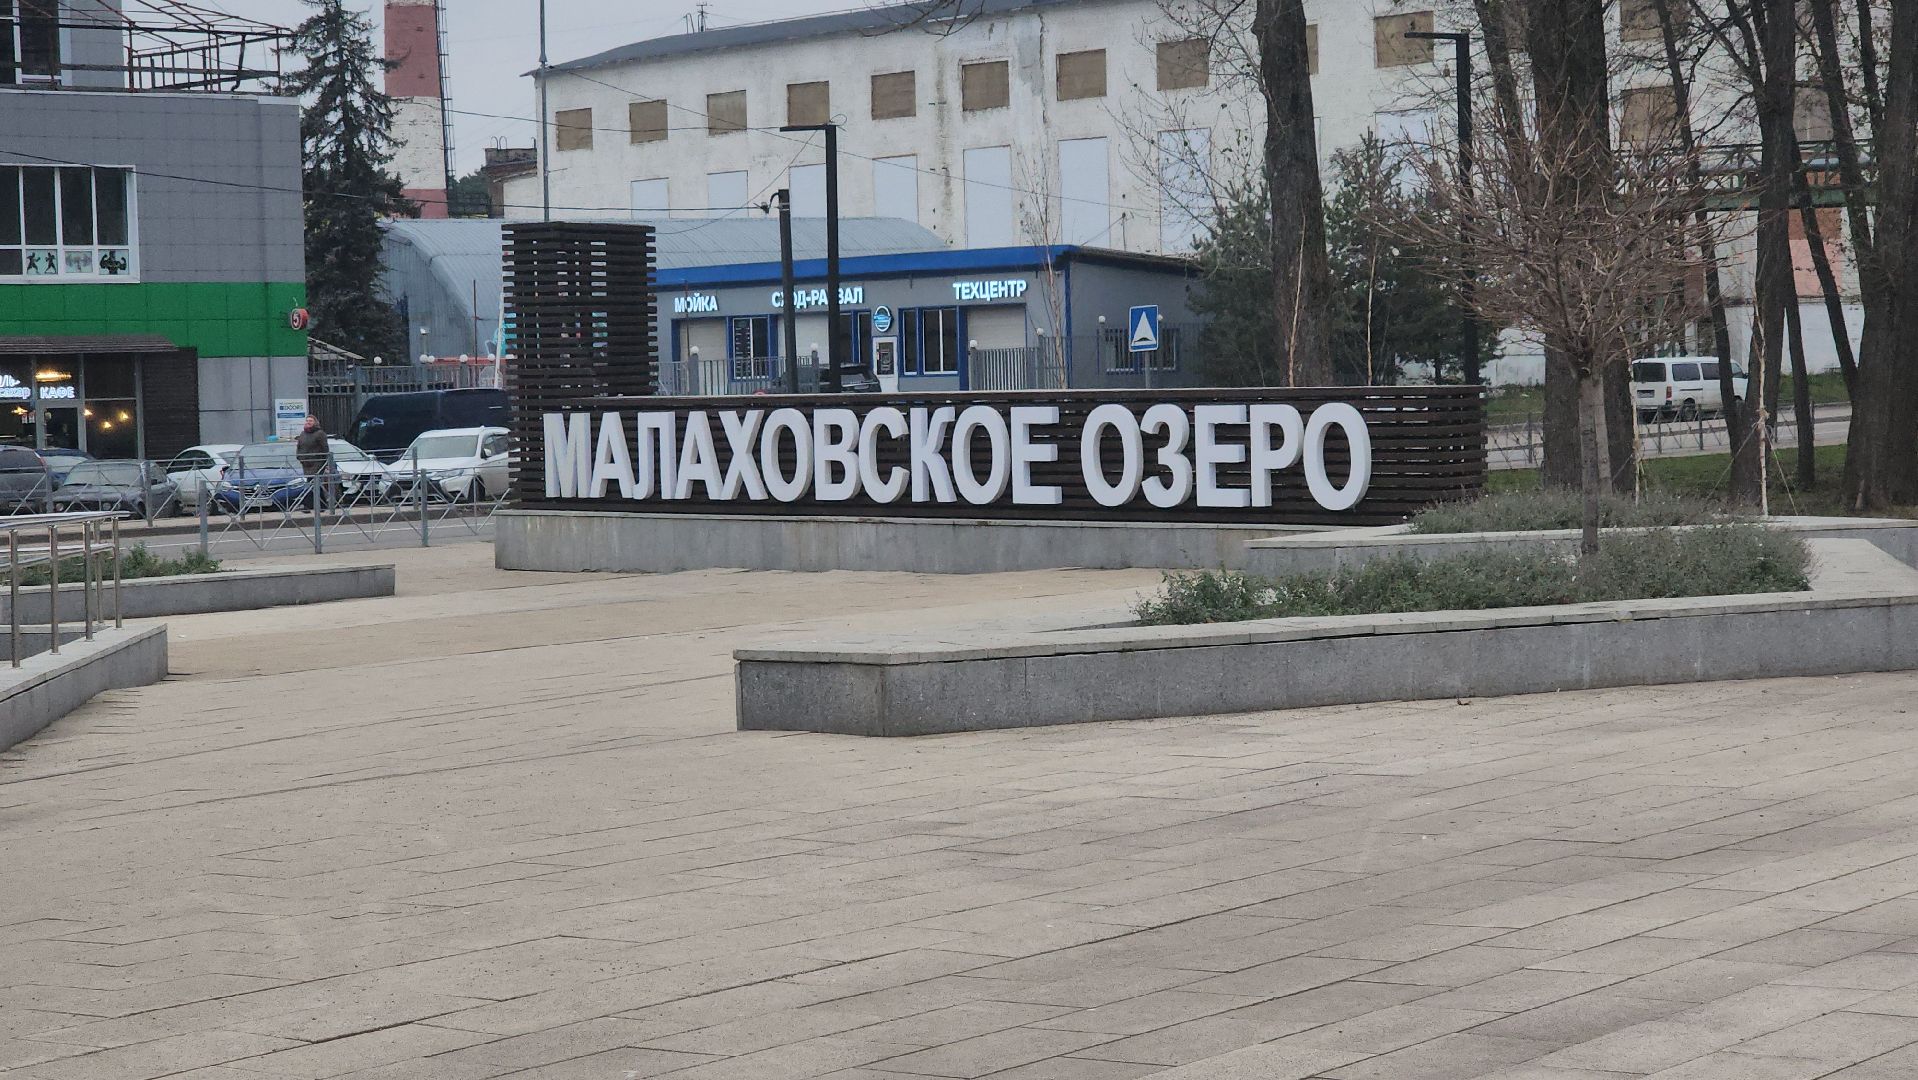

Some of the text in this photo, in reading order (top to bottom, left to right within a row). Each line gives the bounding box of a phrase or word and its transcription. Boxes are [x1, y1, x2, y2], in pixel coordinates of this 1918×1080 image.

[771, 286, 863, 309] СД-РАВАЛ
[952, 279, 1028, 302] ТЕХЦЕНТР
[674, 292, 718, 313] МОЙКА
[40, 386, 75, 399] КАФЕ
[543, 402, 1372, 511] МАЛАХОВСКОЕ ОЗЕРО
